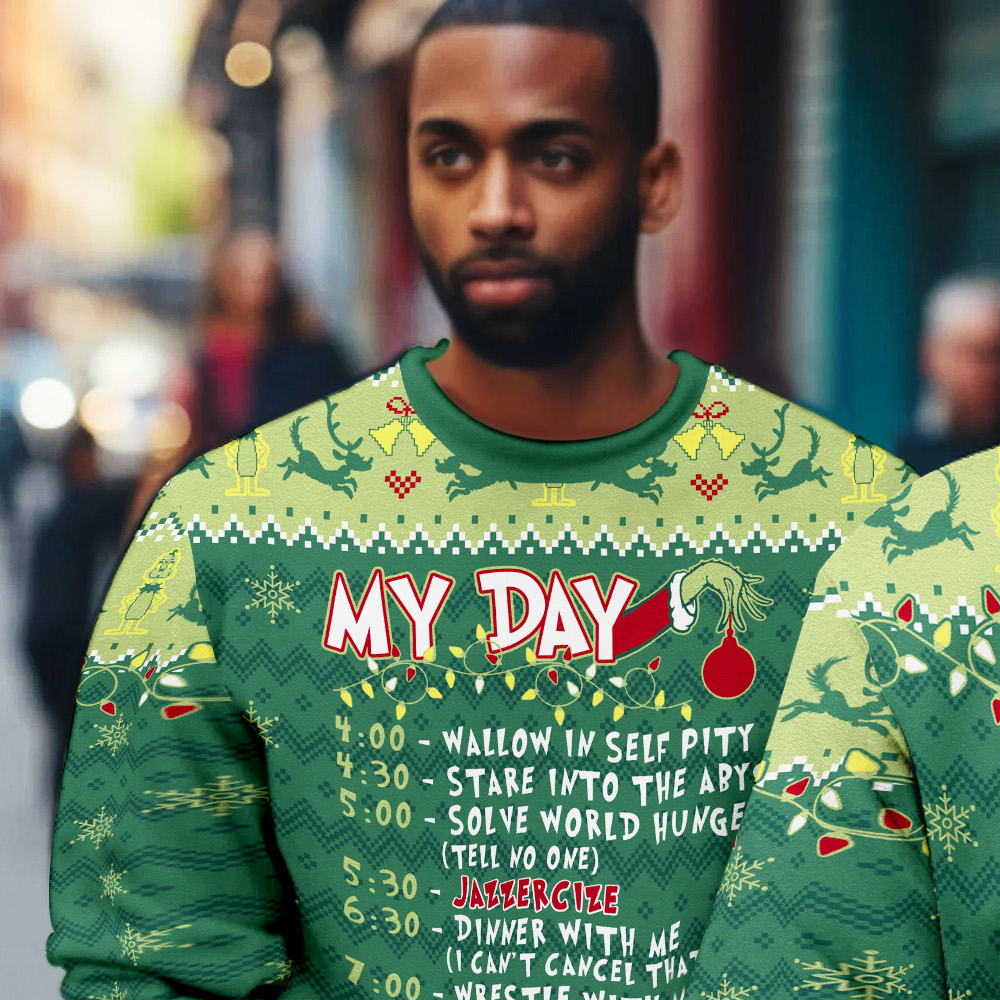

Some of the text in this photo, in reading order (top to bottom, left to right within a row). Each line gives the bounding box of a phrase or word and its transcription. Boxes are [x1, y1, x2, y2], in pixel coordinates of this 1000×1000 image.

[324, 567, 637, 663] MY DAY
[335, 714, 405, 752] 4:00
[442, 725, 552, 759] WALLOW
[565, 728, 596, 758] IN
[605, 731, 670, 764] SELF
[681, 723, 755, 760] PITY
[336, 751, 409, 790] 4:30
[446, 765, 535, 798] STARE
[548, 767, 619, 803] INTO
[631, 767, 687, 807] THE
[698, 762, 761, 796] ABY
[340, 787, 412, 829] 5:00
[448, 804, 529, 836] SOLVE
[539, 804, 640, 842] WORLD
[343, 855, 418, 900] 5:30
[452, 875, 620, 917] JAZZERCIZE
[441, 841, 599, 876] (TELL NO ONE)
[343, 895, 420, 939] 6:30
[453, 914, 547, 949] DINNER
[557, 918, 636, 958] WITH
[648, 920, 681, 959] ME
[470, 950, 536, 978] CAN'T
[544, 952, 636, 986] CANCEL
